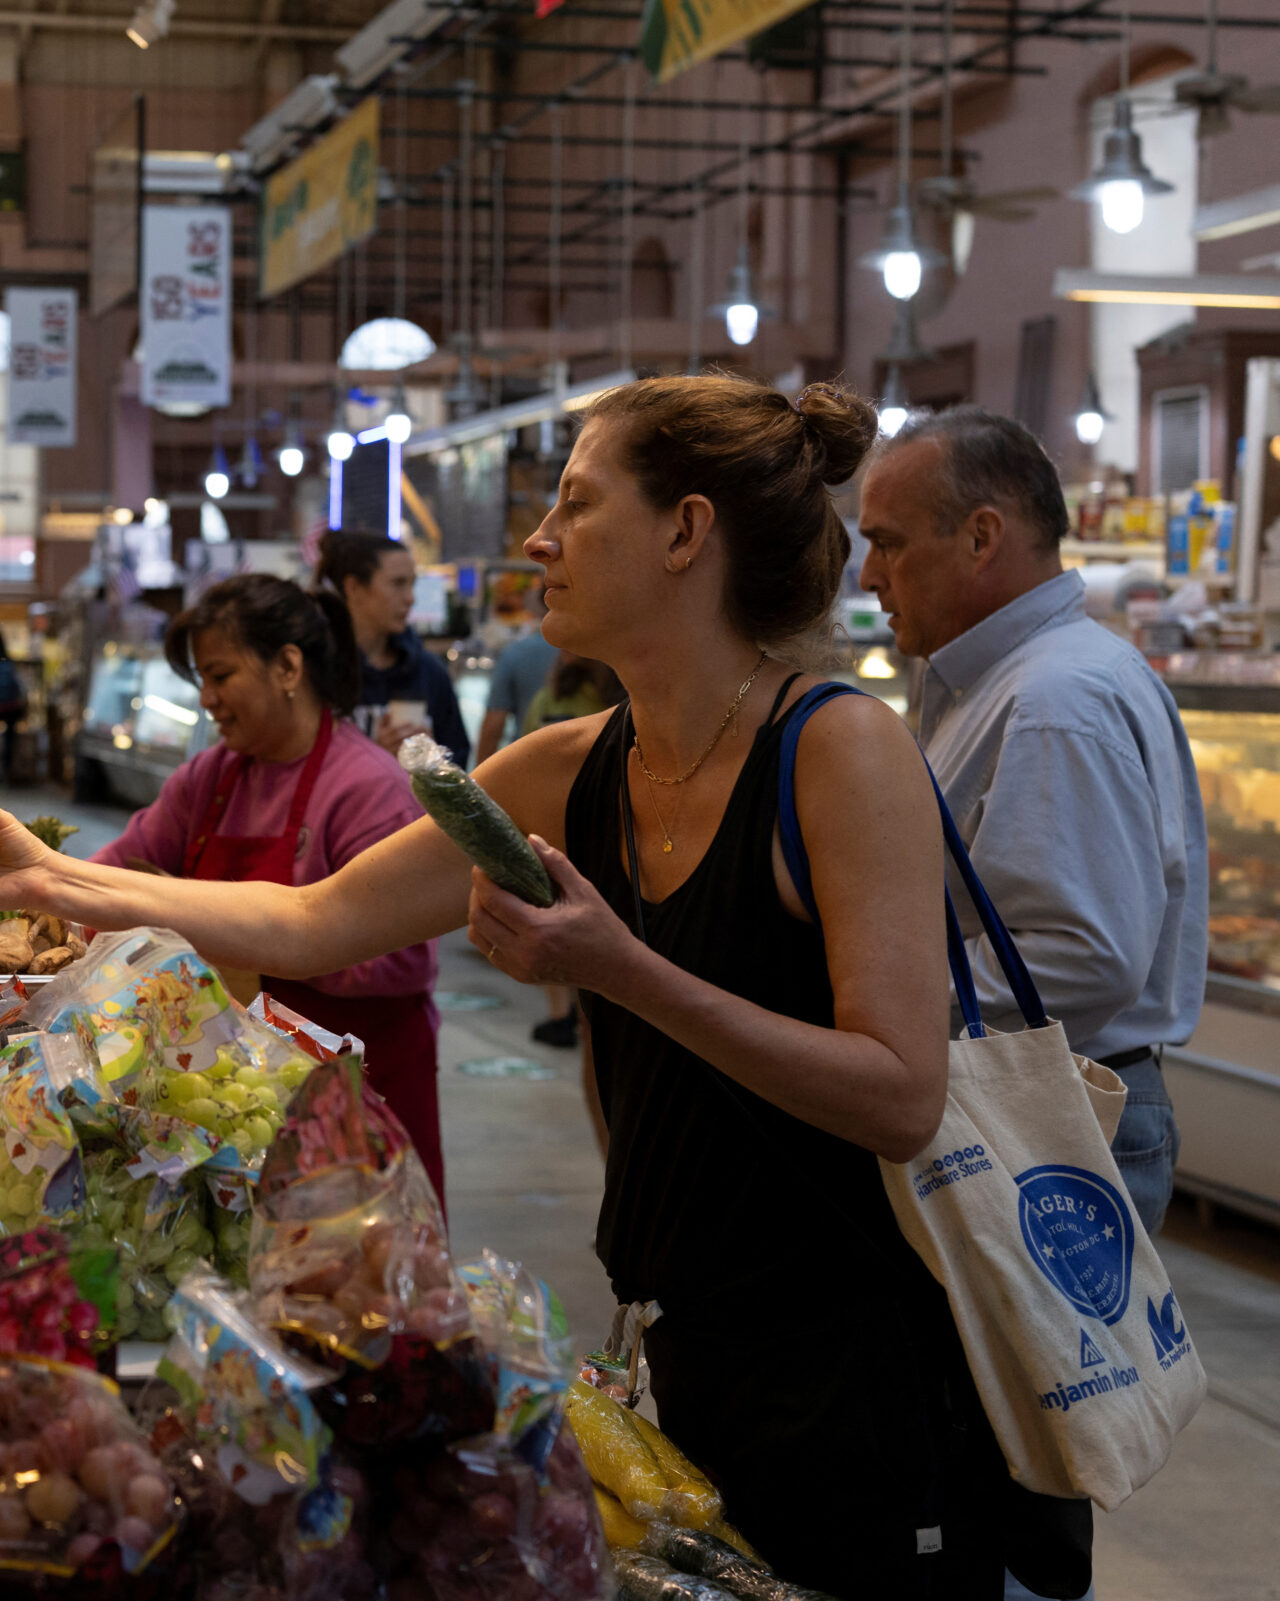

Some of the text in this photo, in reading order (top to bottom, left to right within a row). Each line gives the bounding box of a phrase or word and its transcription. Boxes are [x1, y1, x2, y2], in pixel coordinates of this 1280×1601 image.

[187, 221, 221, 322] YEARS
[151, 276, 183, 322] 150
[916, 1159, 993, 1200] Hardware Stores
[1090, 1233, 1101, 1246] DC
[1147, 1287, 1187, 1361] AC
[1160, 1360, 1172, 1372] The
